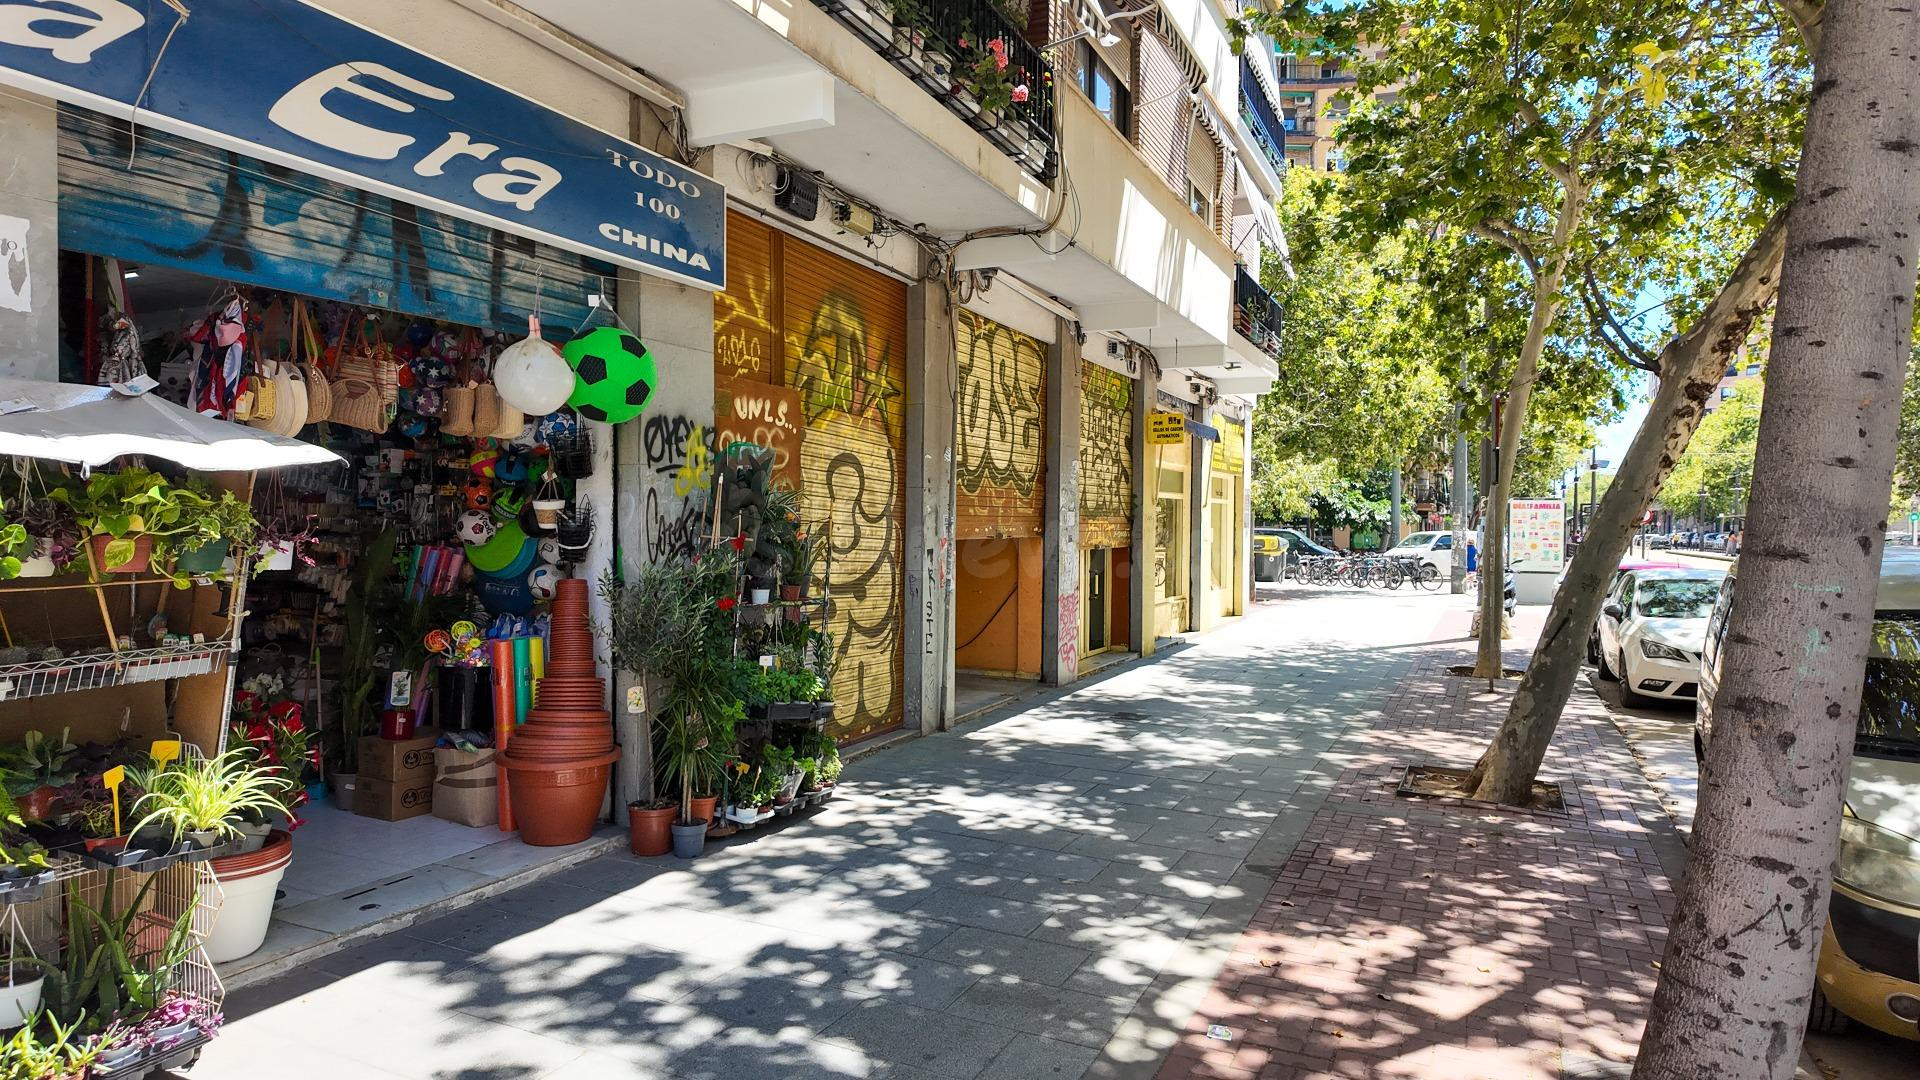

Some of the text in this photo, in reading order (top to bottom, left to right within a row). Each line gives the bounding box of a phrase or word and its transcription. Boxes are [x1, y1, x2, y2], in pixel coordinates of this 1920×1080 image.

[268, 61, 562, 211] Era
[605, 146, 701, 199] TODO
[633, 190, 682, 222] 100
[598, 222, 711, 272] CHINA
